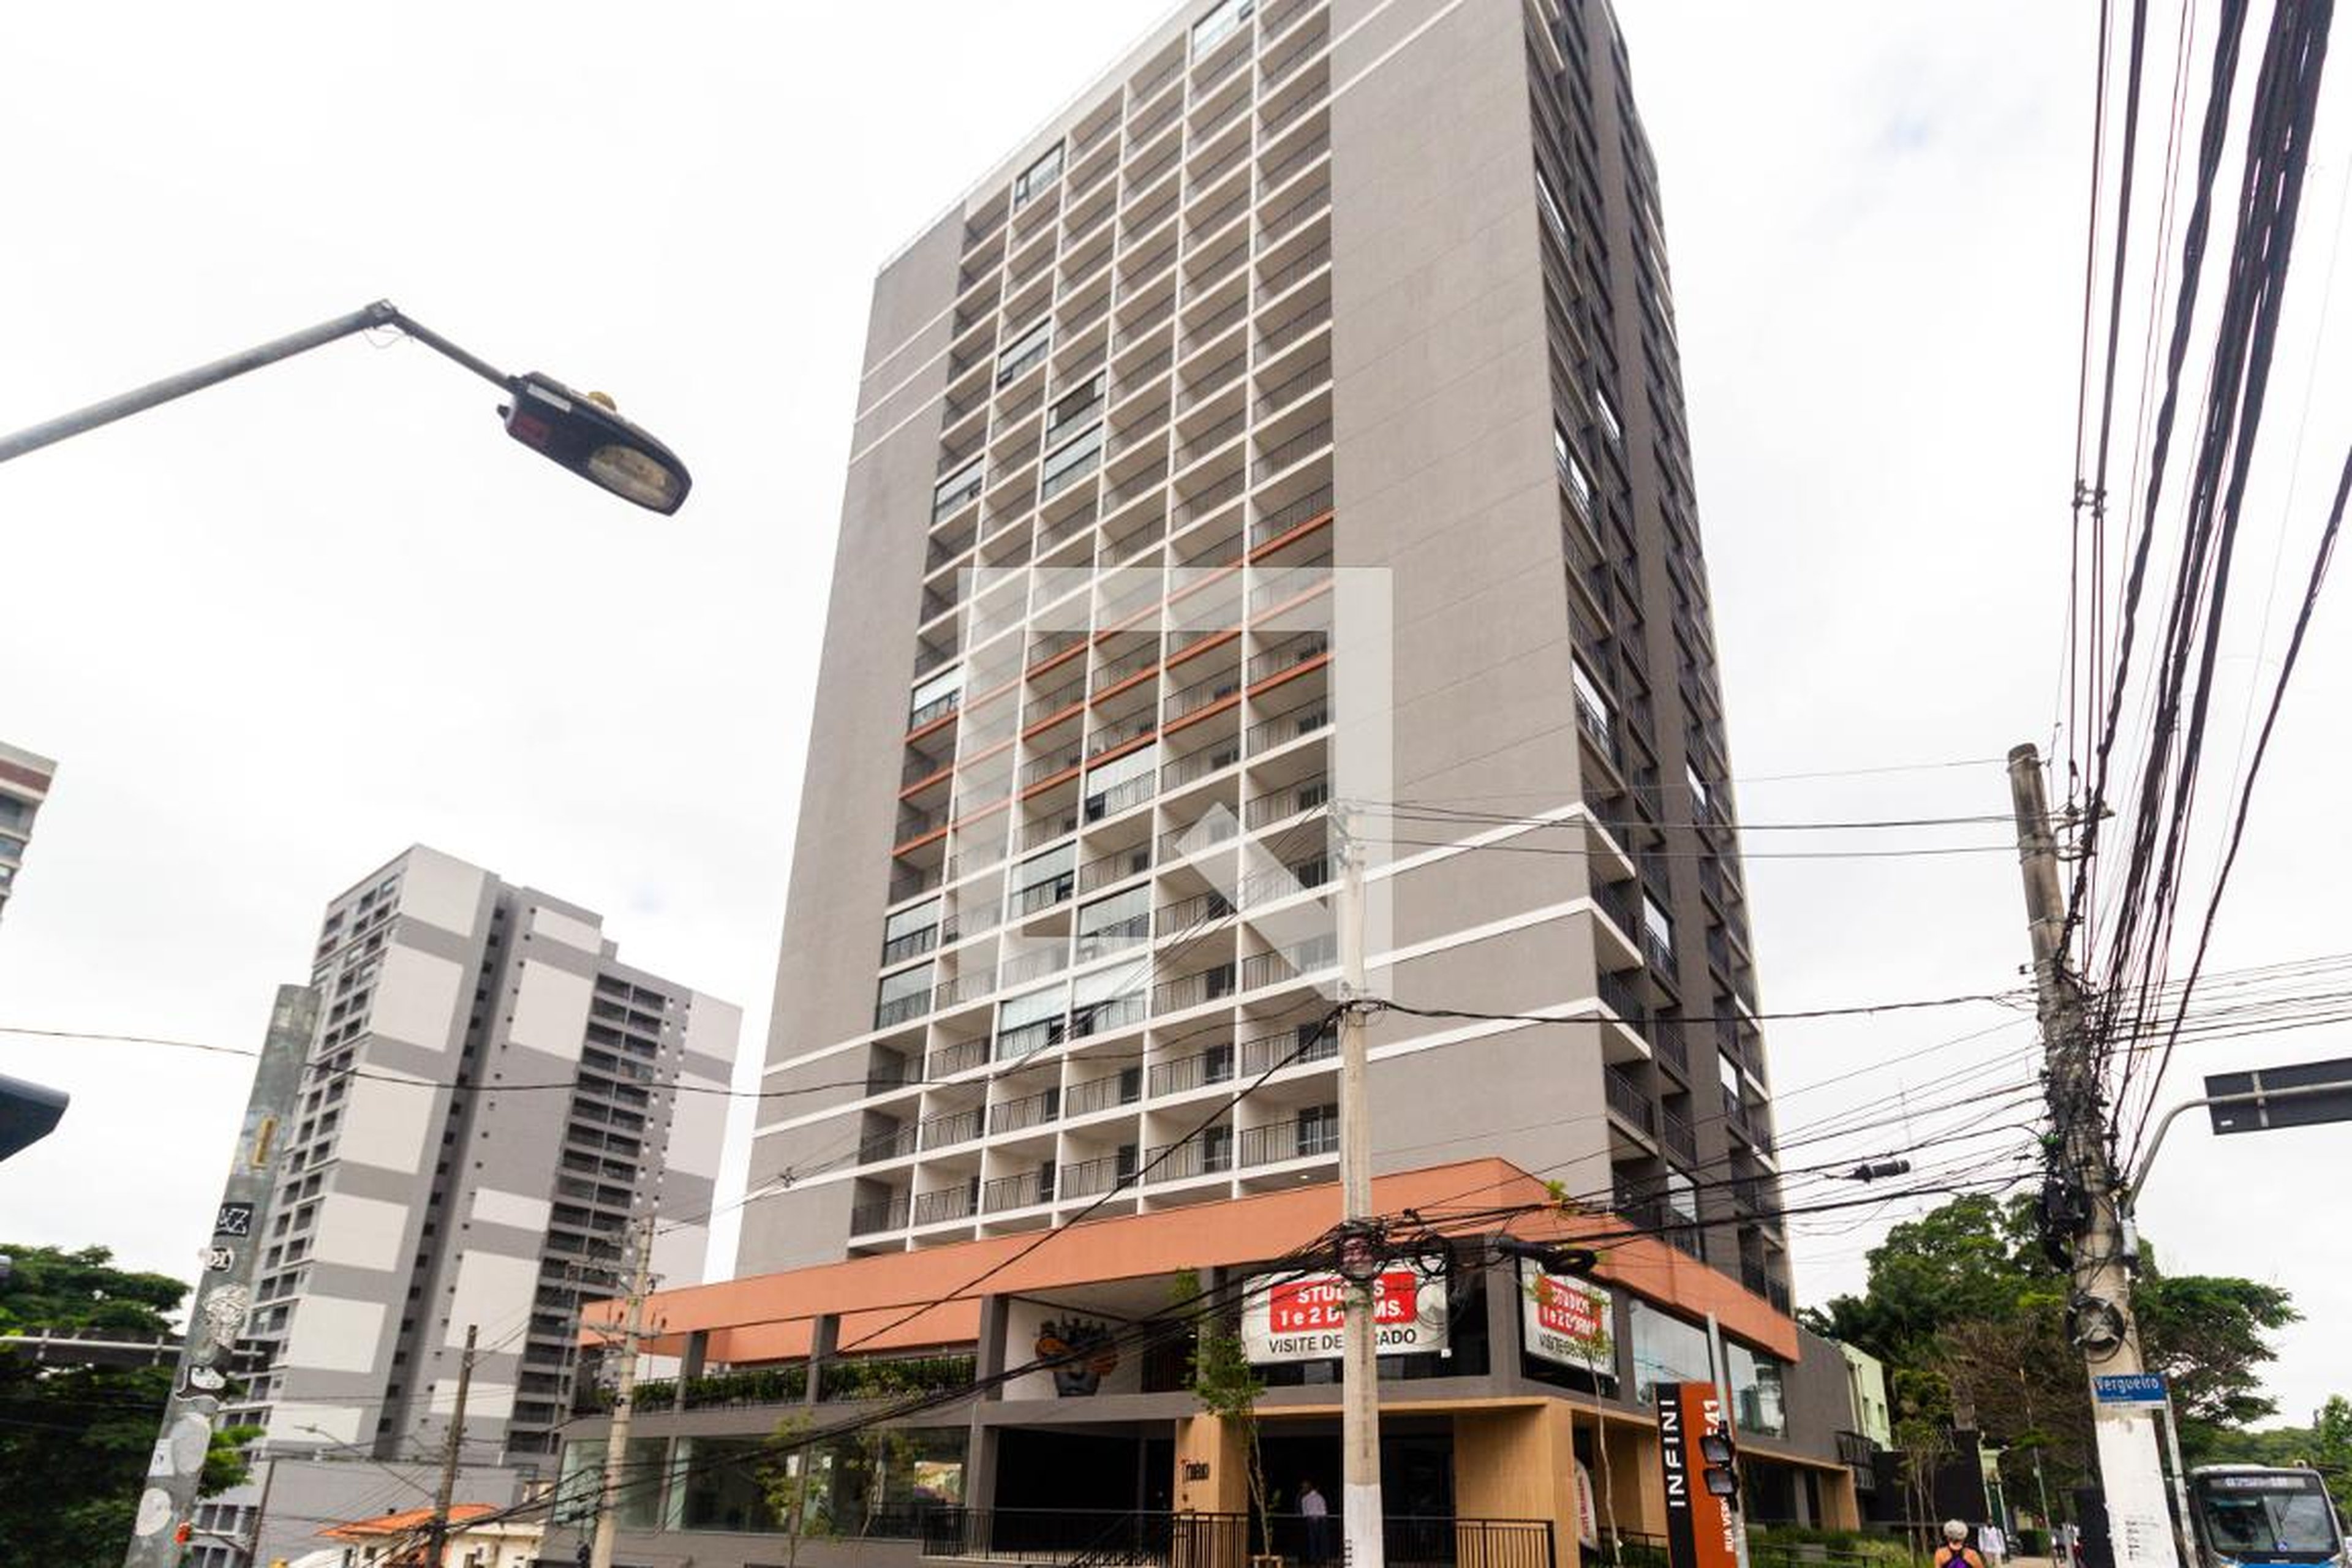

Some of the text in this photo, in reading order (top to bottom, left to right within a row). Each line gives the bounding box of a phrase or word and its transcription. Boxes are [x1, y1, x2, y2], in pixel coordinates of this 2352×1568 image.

[1298, 1279, 1384, 1303] STUS
[1280, 1300, 1404, 1325] 1 e 2 DMS.
[1269, 1329, 1416, 1353] VISITE DEADO
[2095, 1376, 2159, 1393] Vergueiro
[1660, 1400, 1686, 1507] INFINI
